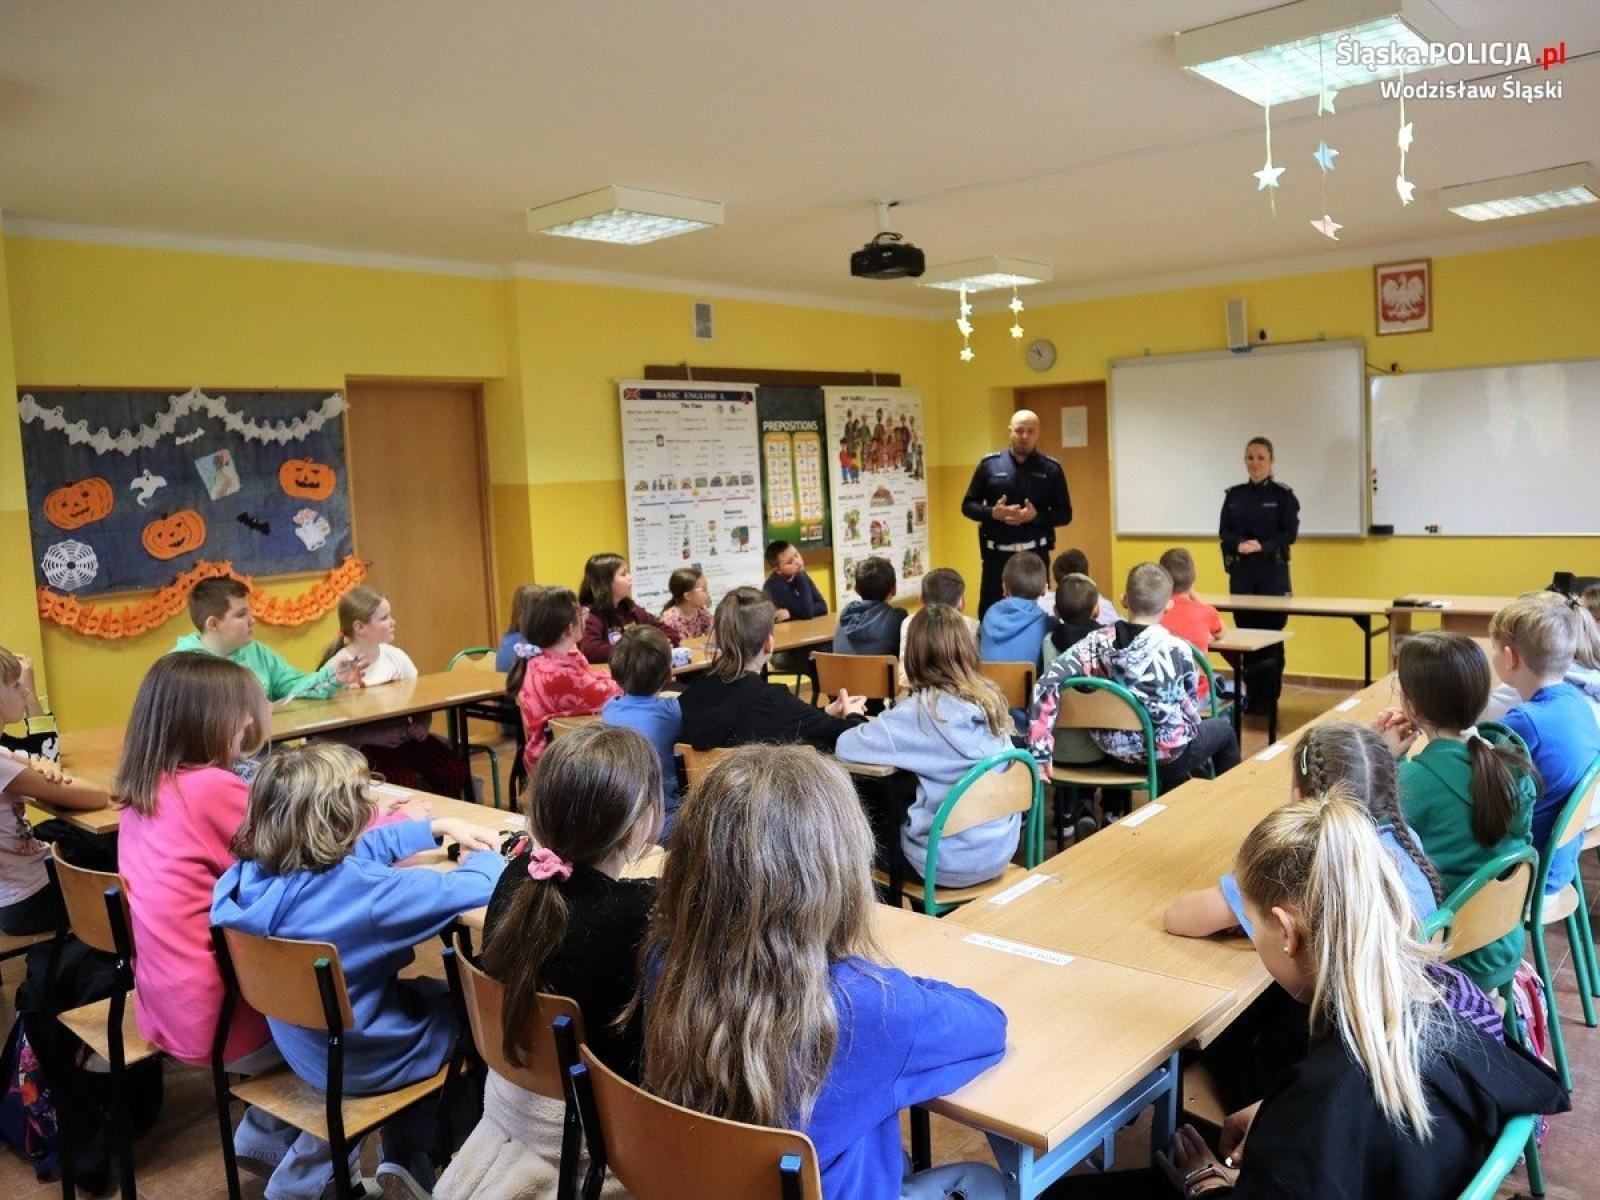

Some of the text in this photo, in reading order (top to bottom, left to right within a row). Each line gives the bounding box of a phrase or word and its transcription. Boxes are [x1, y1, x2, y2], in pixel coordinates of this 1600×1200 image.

[655, 391, 679, 400] BASIC
[683, 391, 717, 401] ENGLISH
[762, 420, 818, 432] PREPOSITIONS
